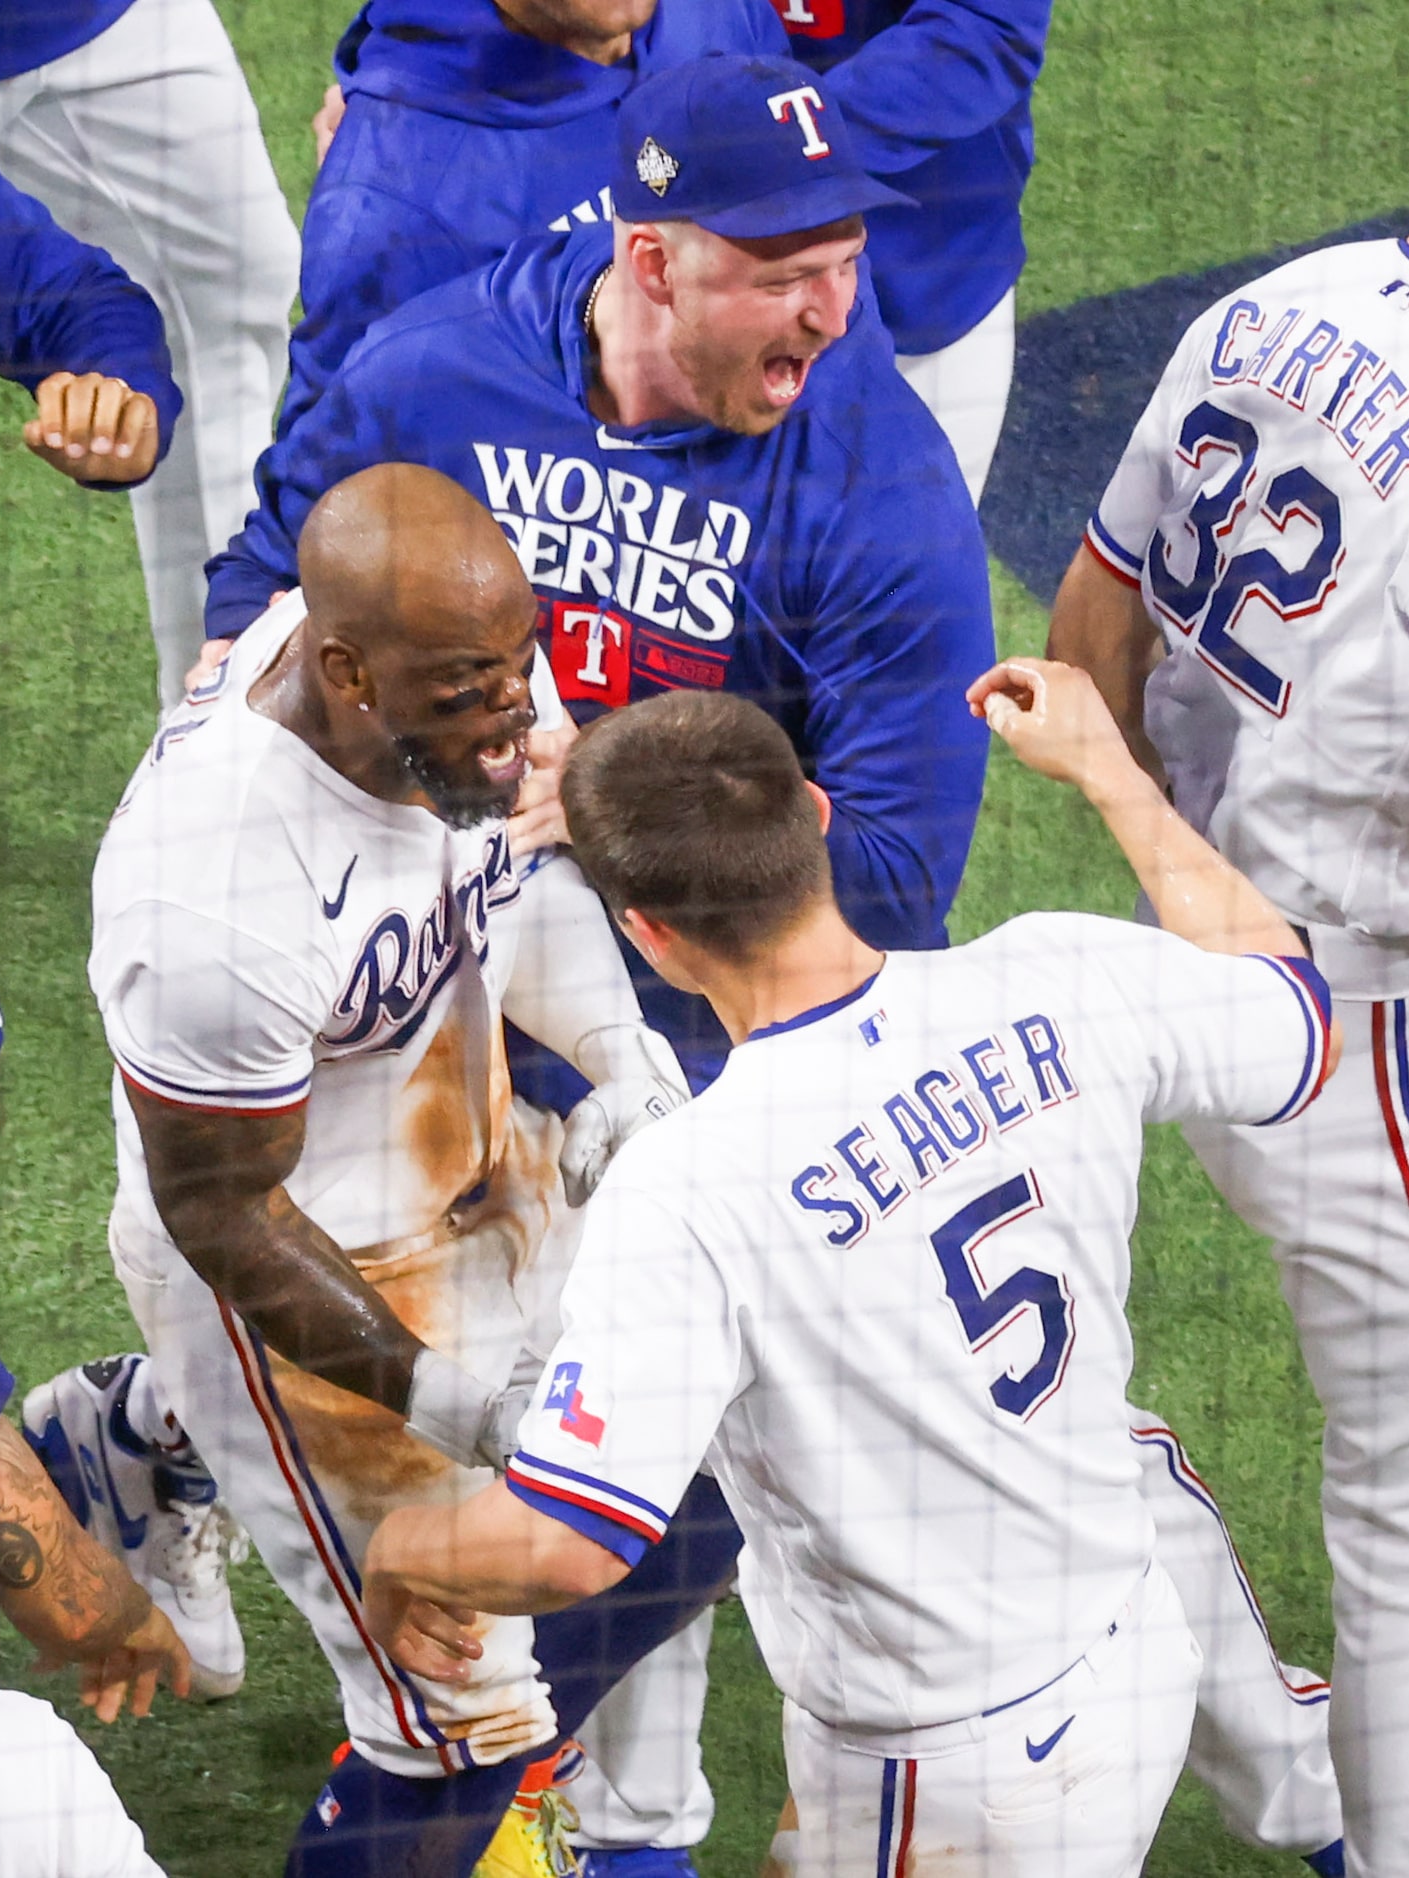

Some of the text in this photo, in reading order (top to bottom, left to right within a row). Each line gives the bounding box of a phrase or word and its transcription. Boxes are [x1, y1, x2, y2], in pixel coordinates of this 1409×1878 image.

[766, 86, 832, 161] T
[472, 442, 752, 570] WORLD
[1147, 398, 1348, 720] 32
[562, 609, 623, 686] T
[791, 1012, 1081, 1250] SEAGER
[929, 1167, 1077, 1425] 5
